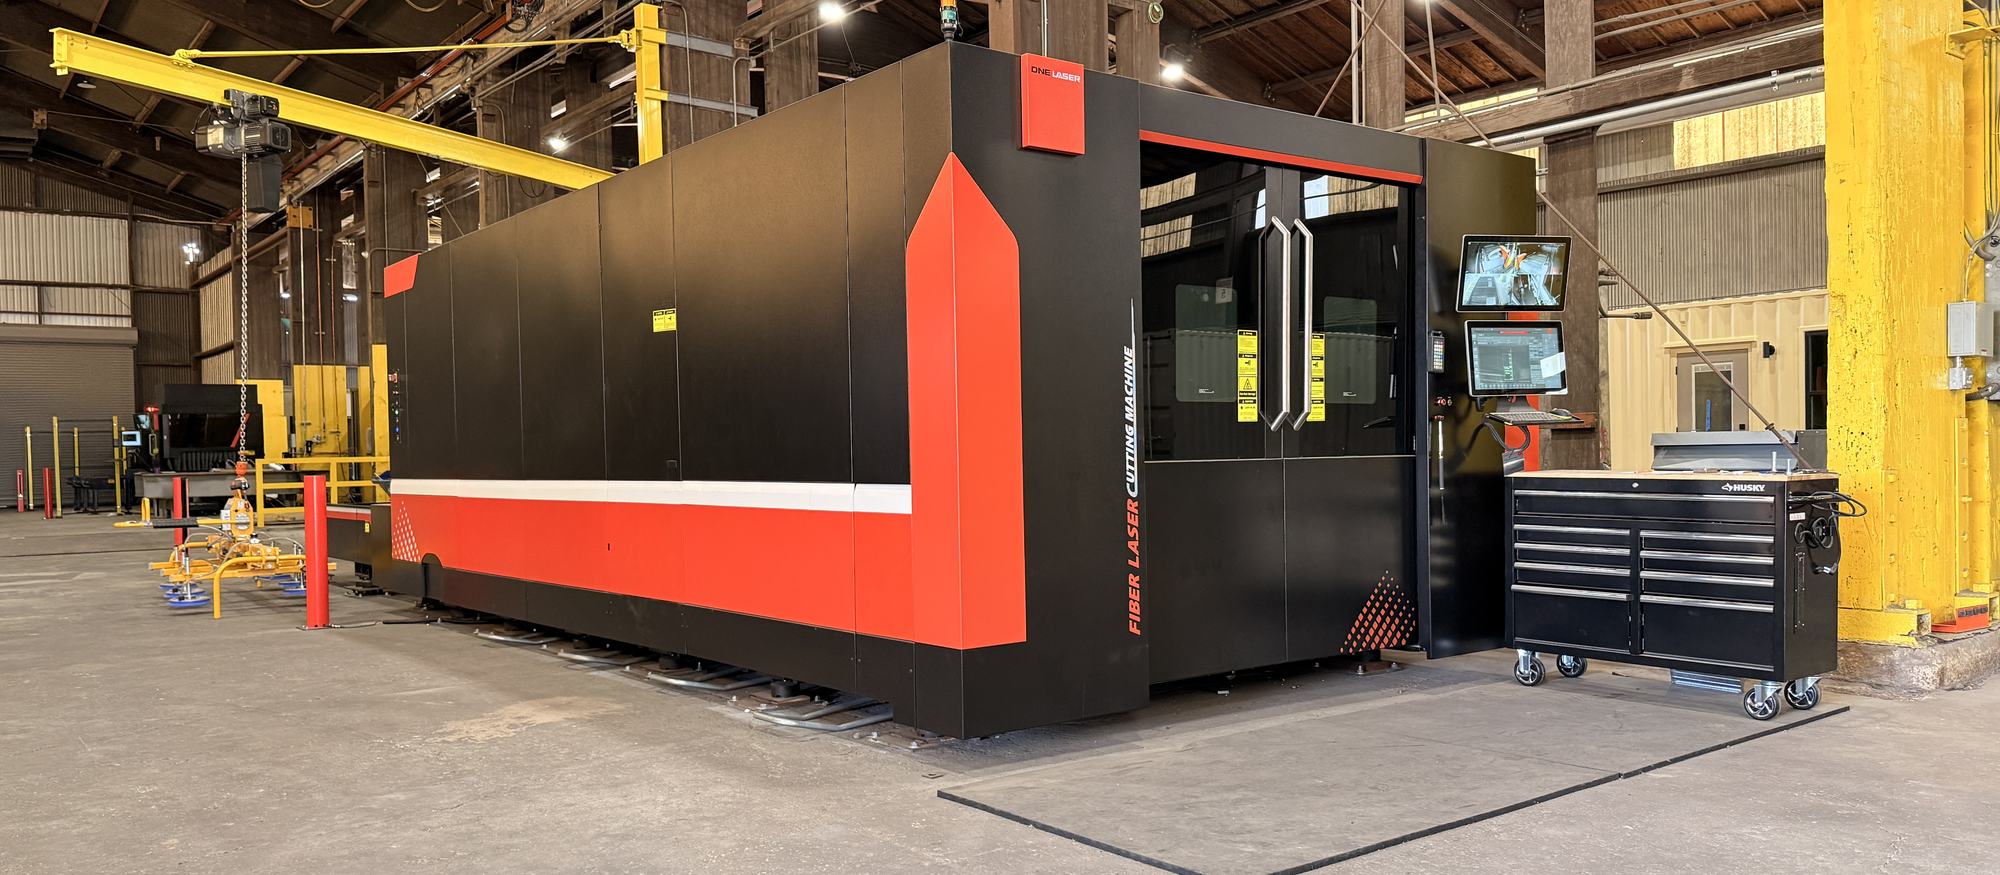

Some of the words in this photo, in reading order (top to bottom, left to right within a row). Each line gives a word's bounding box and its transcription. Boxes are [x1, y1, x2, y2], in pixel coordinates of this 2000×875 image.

[1031, 66, 1051, 76] ONE
[1052, 70, 1081, 83] LASER
[1124, 345, 1135, 422] MACHINE
[1126, 424, 1138, 498] CUTTING
[1733, 484, 1766, 493] HUSKY
[1127, 498, 1140, 569] LASER
[1128, 573, 1141, 636] FIBER
